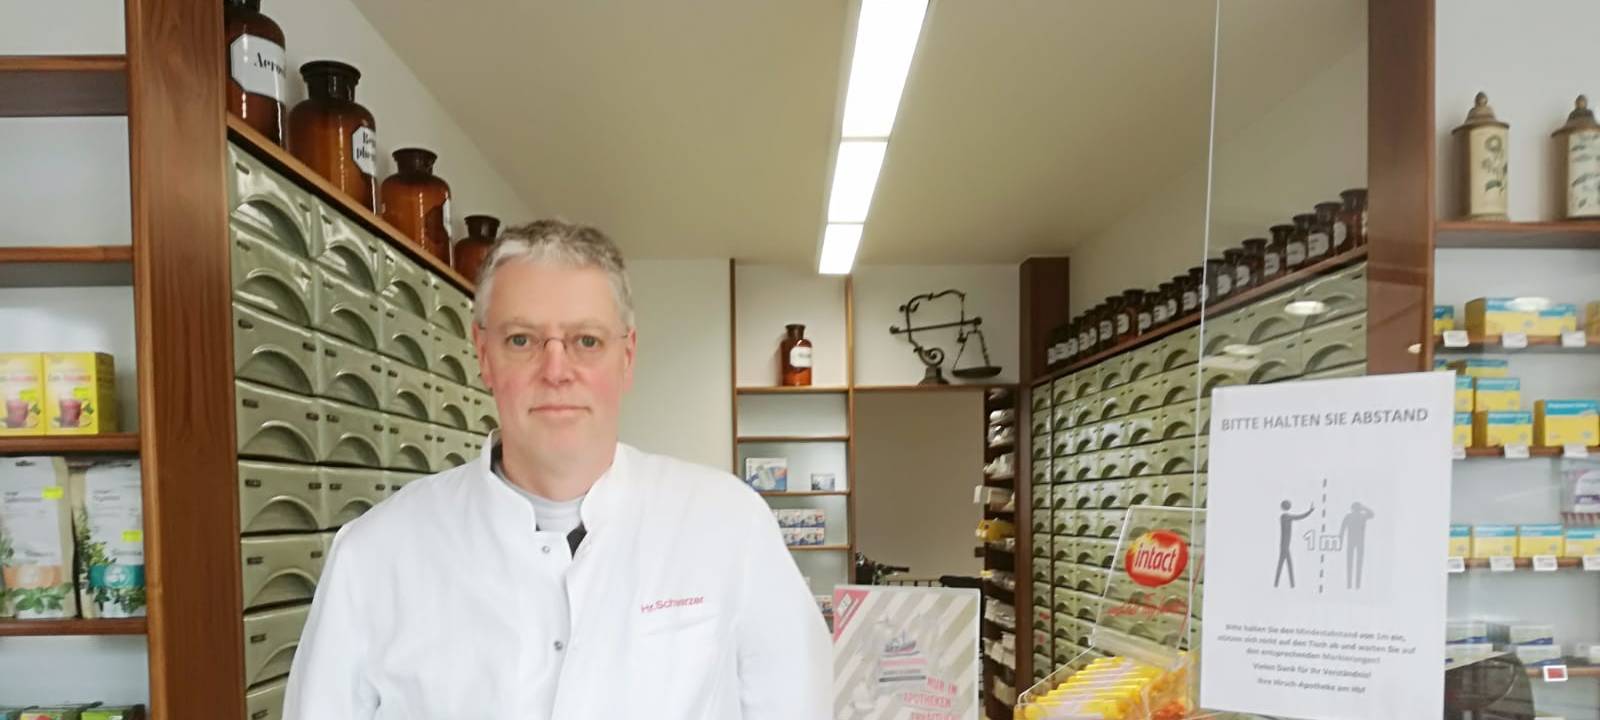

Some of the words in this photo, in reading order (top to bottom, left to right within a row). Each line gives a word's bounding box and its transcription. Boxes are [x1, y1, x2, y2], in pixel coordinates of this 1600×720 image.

[1221, 416, 1259, 431] BITTE
[1263, 413, 1320, 429] HALTEN
[1324, 411, 1347, 426] SIE
[1351, 408, 1429, 425] ABSTAND
[1134, 542, 1176, 572] intact
[1244, 624, 1265, 632] halten
[1280, 626, 1294, 634] den
[1296, 628, 1358, 638] Mindestabstand
[1261, 649, 1320, 660] entsprechenden
[1308, 640, 1328, 648] Tisch
[1388, 645, 1400, 653] Sie
[1401, 646, 1416, 655] auf
[1253, 662, 1275, 671] Vielen
[1277, 664, 1296, 672] Dank
[1297, 665, 1308, 673] für
